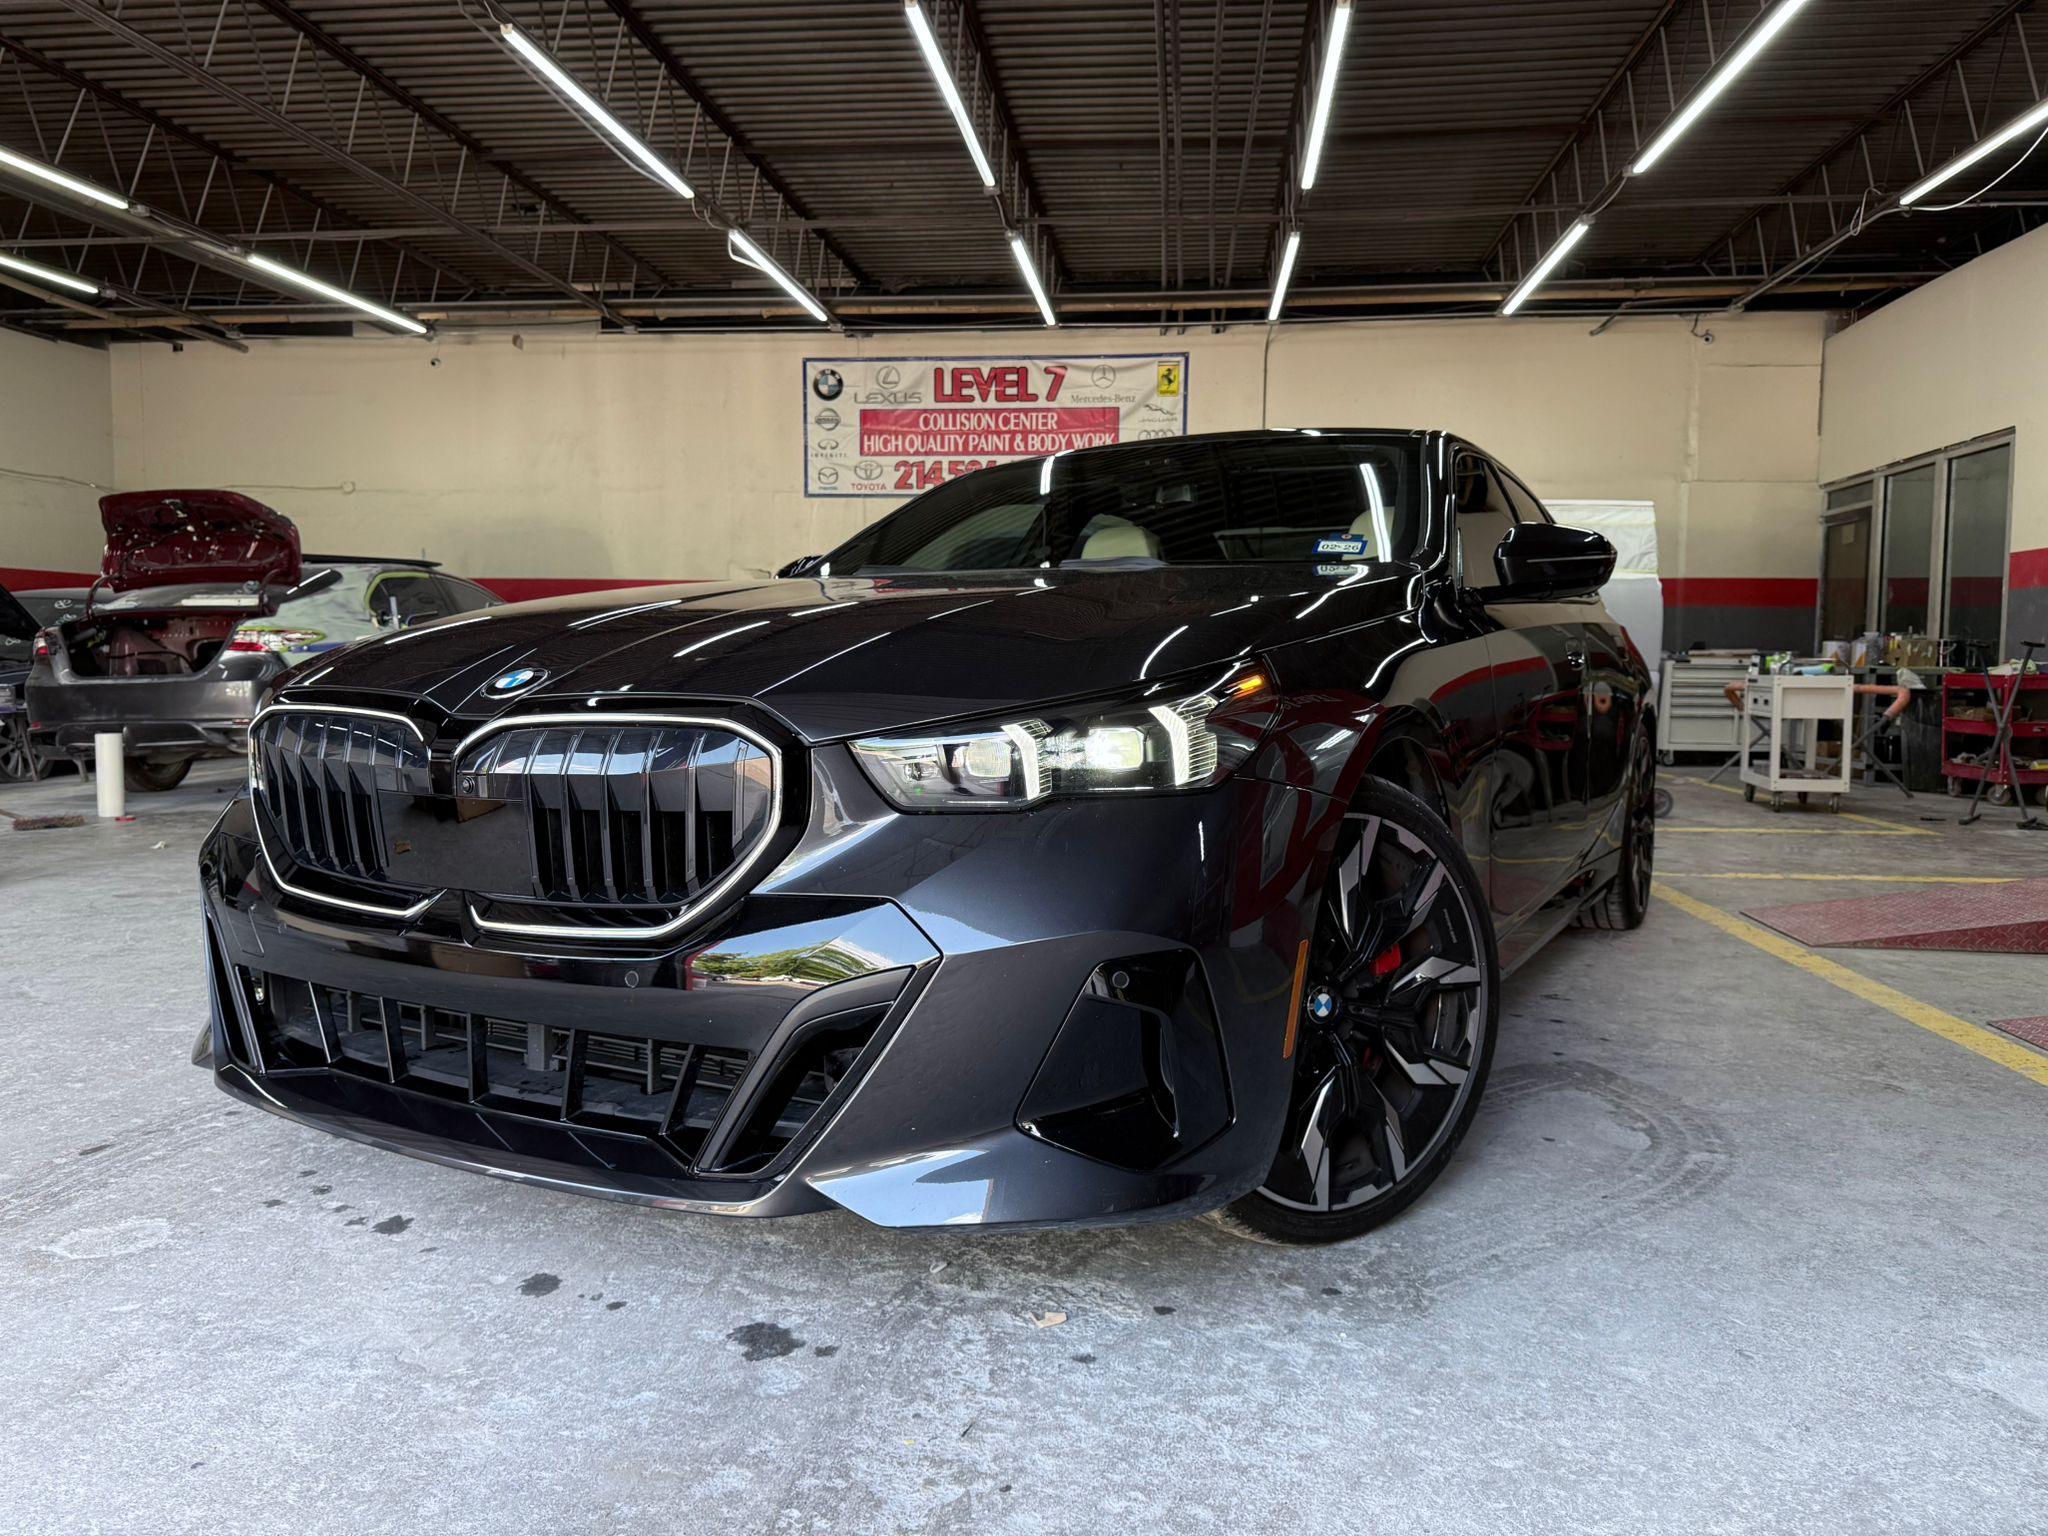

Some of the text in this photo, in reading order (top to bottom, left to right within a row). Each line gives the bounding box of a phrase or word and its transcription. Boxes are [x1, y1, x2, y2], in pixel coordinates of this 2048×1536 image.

[934, 365, 1068, 403] LEVEL 7
[854, 392, 922, 404] LEXUS
[1071, 394, 1136, 404] Mercedes-Benz
[919, 412, 1058, 431] COLLISION CENTER
[863, 432, 1116, 454] HIGH QUALITY PAINT & BODY WORK
[851, 483, 887, 491] TOYOTA
